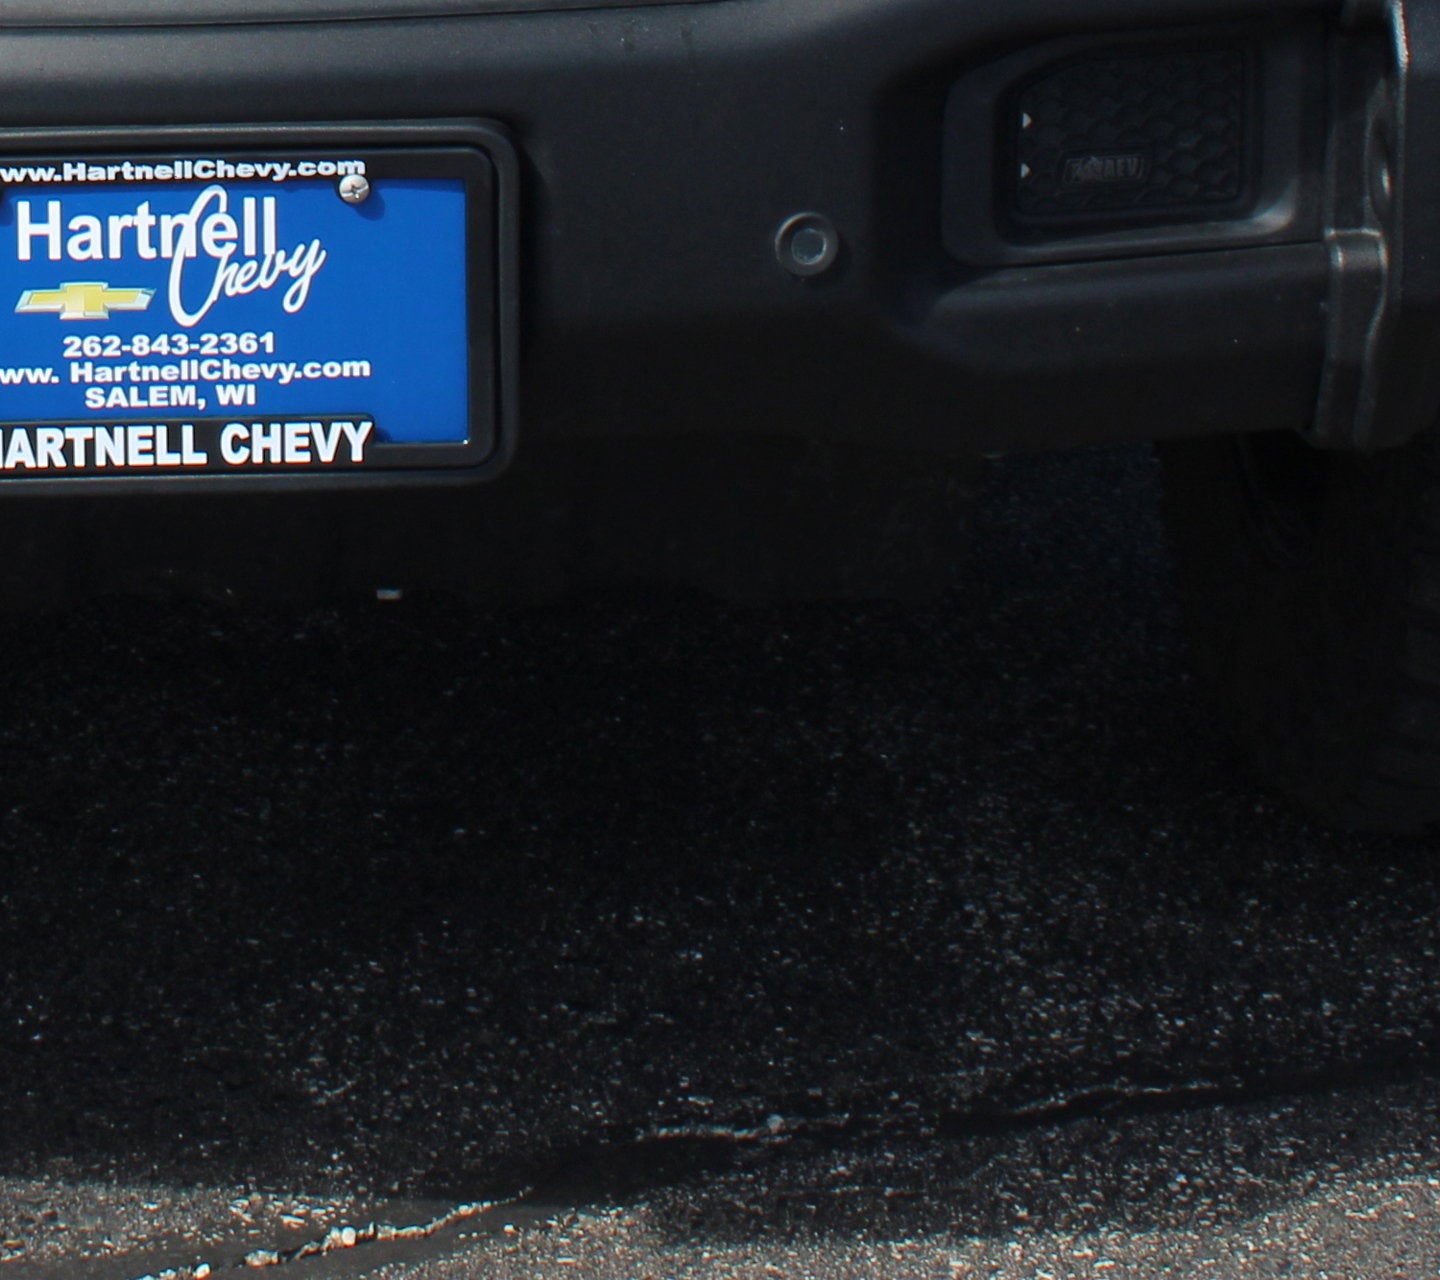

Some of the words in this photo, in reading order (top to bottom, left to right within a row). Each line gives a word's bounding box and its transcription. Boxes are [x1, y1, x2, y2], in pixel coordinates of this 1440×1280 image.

[16, 195, 277, 261] Hartnell
[168, 184, 328, 328] Chevy
[62, 331, 275, 358] 262-843-2361
[69, 358, 372, 384] HartnellChevy.com
[84, 385, 206, 410] SALEM,
[215, 383, 257, 406] WI
[220, 421, 373, 465] CHEVY
